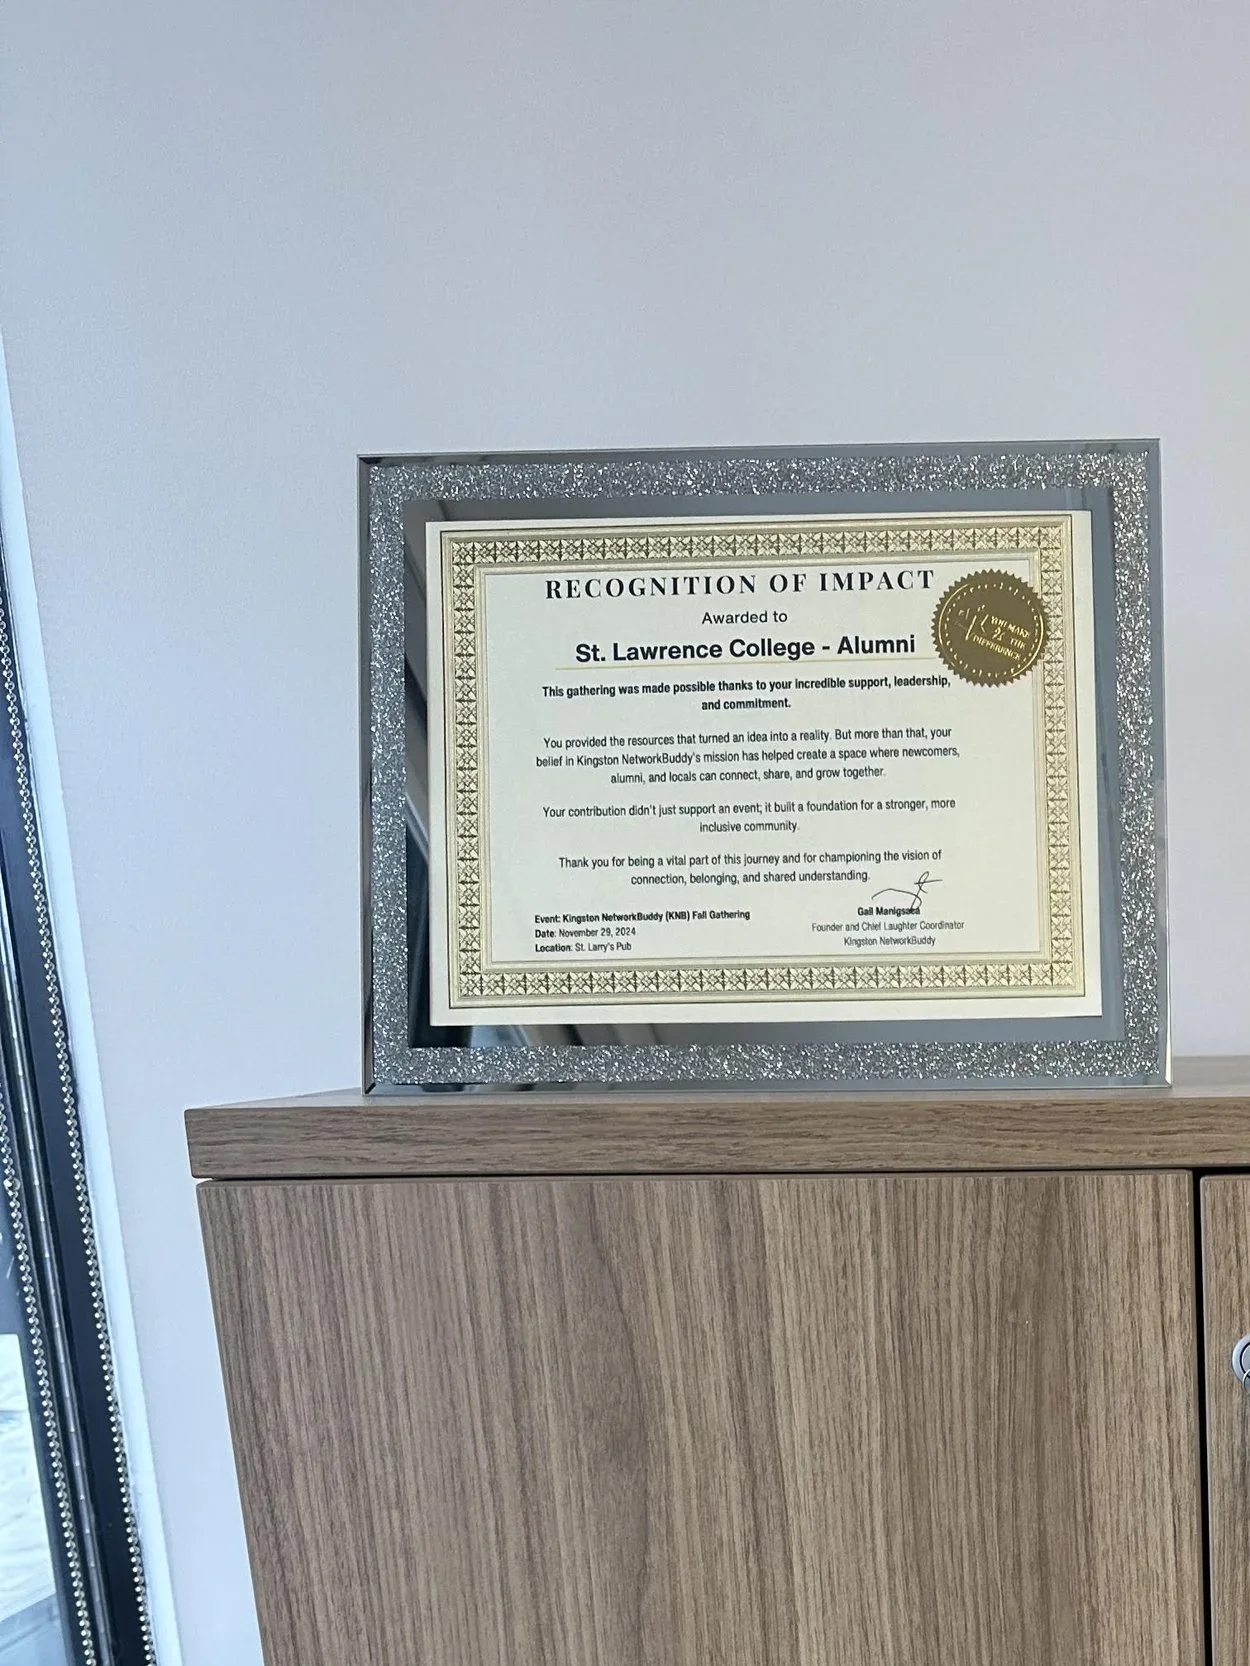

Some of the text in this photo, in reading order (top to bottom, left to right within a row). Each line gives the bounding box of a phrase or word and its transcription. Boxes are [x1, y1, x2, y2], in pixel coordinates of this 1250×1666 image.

[545, 570, 933, 599] RECOGNITION OF IMPACT
[701, 610, 787, 624] Awarded to
[575, 643, 605, 662] St.
[613, 642, 722, 661] Lawrence
[729, 637, 815, 661] College
[836, 634, 914, 654] Alumni
[541, 674, 950, 699] This gathering was made possible thanks to your incredible support, leadership,
[701, 697, 791, 710] and commitment.
[543, 727, 951, 750] You provided the resources that turned an idea into a reality. But more than that, your
[535, 746, 959, 768] belief in Kingston NetworkBuddy's mission has helped create a space where newcomers,
[610, 765, 885, 784] alumni, and locals can connect, share, and grow together.
[542, 799, 955, 817] Your contribution didn't just support an event; it built a foundation for a stronger, more
[699, 820, 799, 833] inclusive community.
[558, 849, 942, 870] Thank you for being a vital part of this journey and for championing the vision of
[630, 869, 870, 885] connection, belonging, and shared understanding.
[562, 913, 599, 924] Kingston
[601, 912, 663, 922] NetworkBuddy
[665, 910, 690, 922] (KNB)
[692, 910, 707, 919] Fall
[709, 909, 750, 920] Gathering
[558, 928, 598, 937] November
[615, 926, 635, 936] 2024
[811, 920, 964, 932] Founder and Chief Laughter Coordinator
[588, 942, 614, 952] Larry's
[616, 941, 631, 950] Pub
[843, 935, 936, 948] Kingston NetworkBuddy
